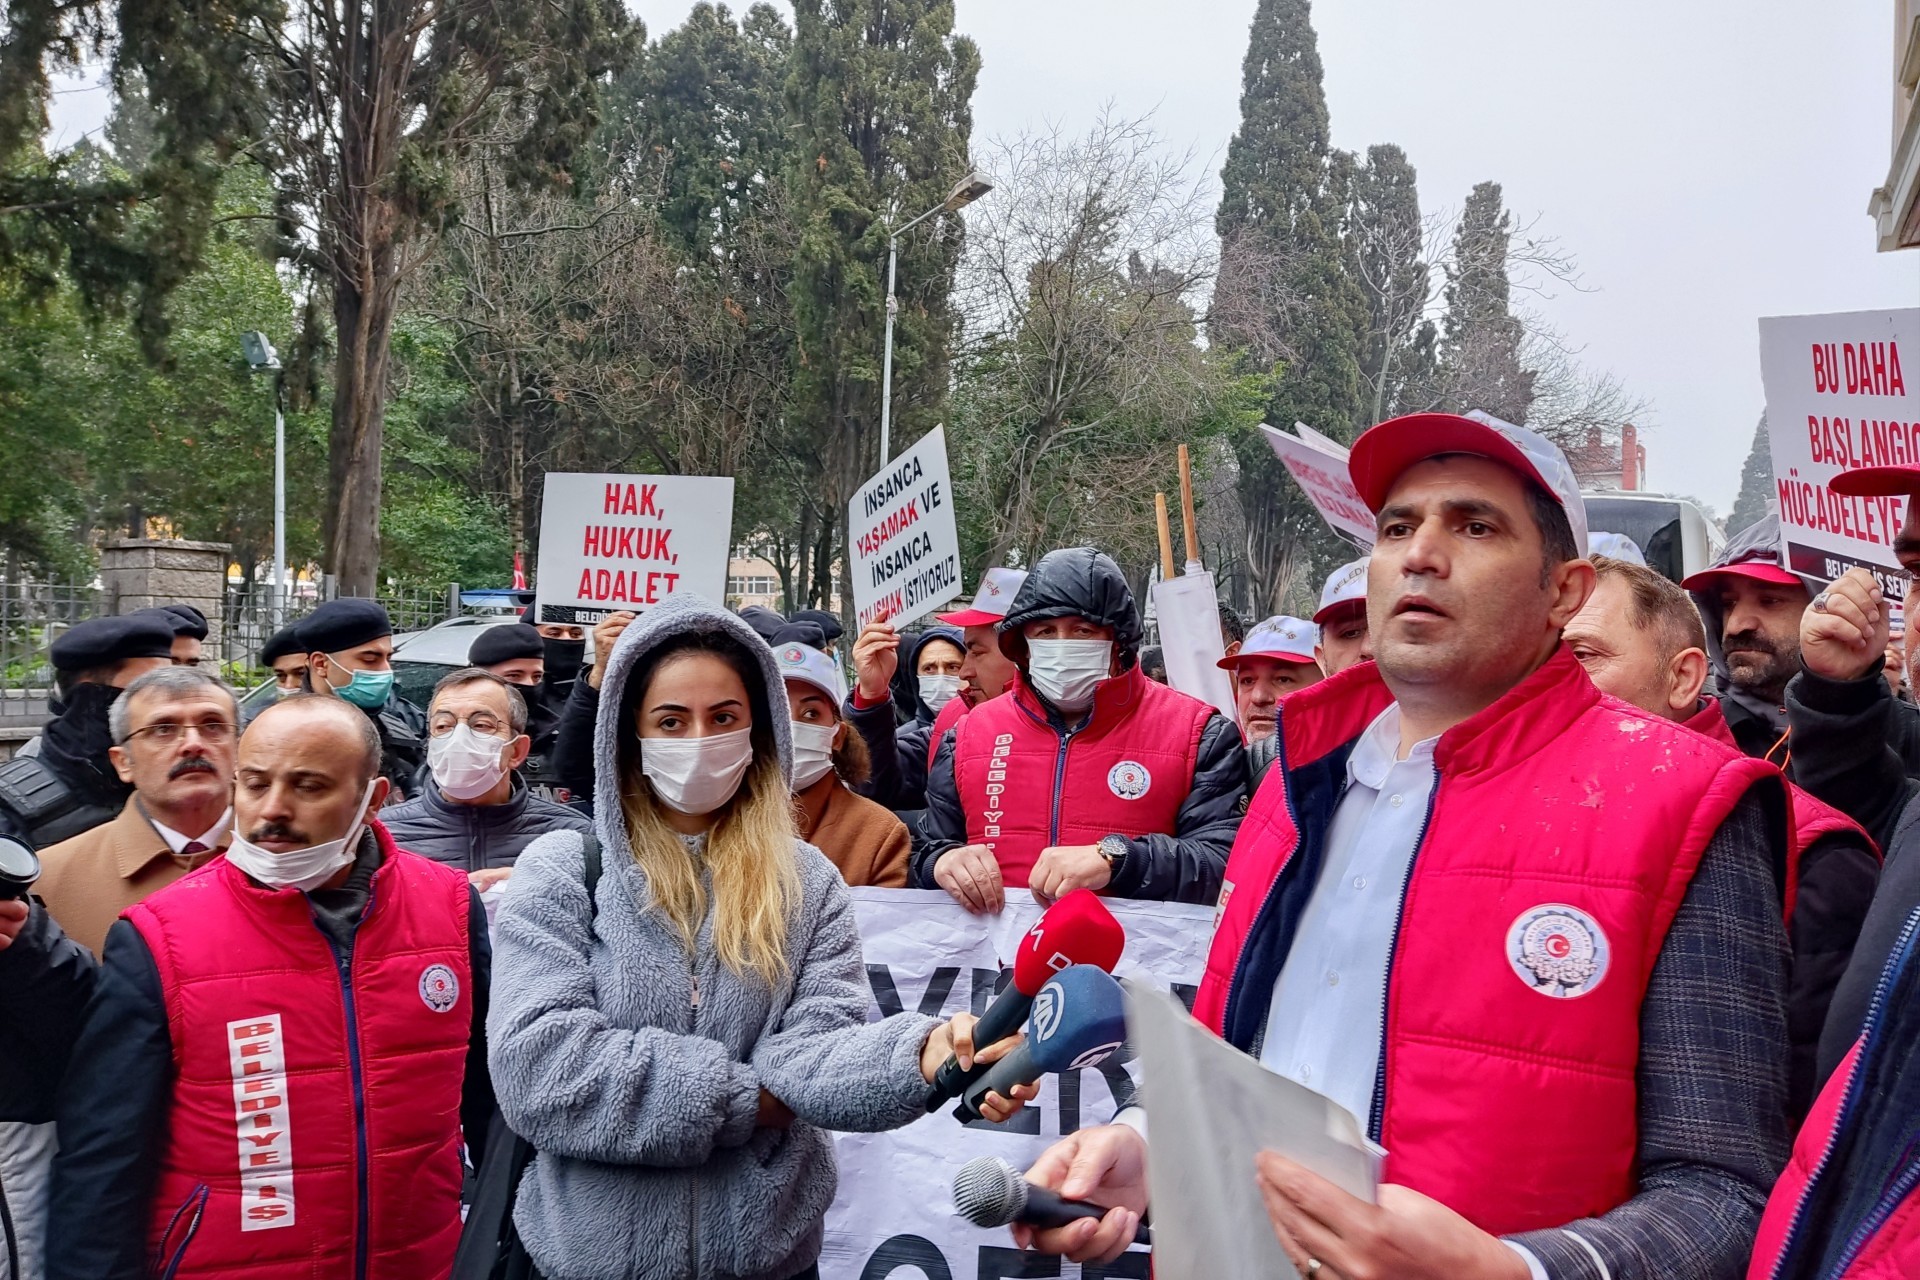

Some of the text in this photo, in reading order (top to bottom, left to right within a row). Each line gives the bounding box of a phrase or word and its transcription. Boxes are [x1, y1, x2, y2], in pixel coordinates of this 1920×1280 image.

[1812, 341, 1906, 397] BU DAHA
[603, 483, 664, 521] HAK,
[864, 455, 923, 518] İNSANCA
[583, 525, 679, 565] HUKUK,
[856, 480, 942, 560] YAŞAMAK VE
[577, 568, 680, 604] ADALET
[871, 531, 932, 588] İNSANCA
